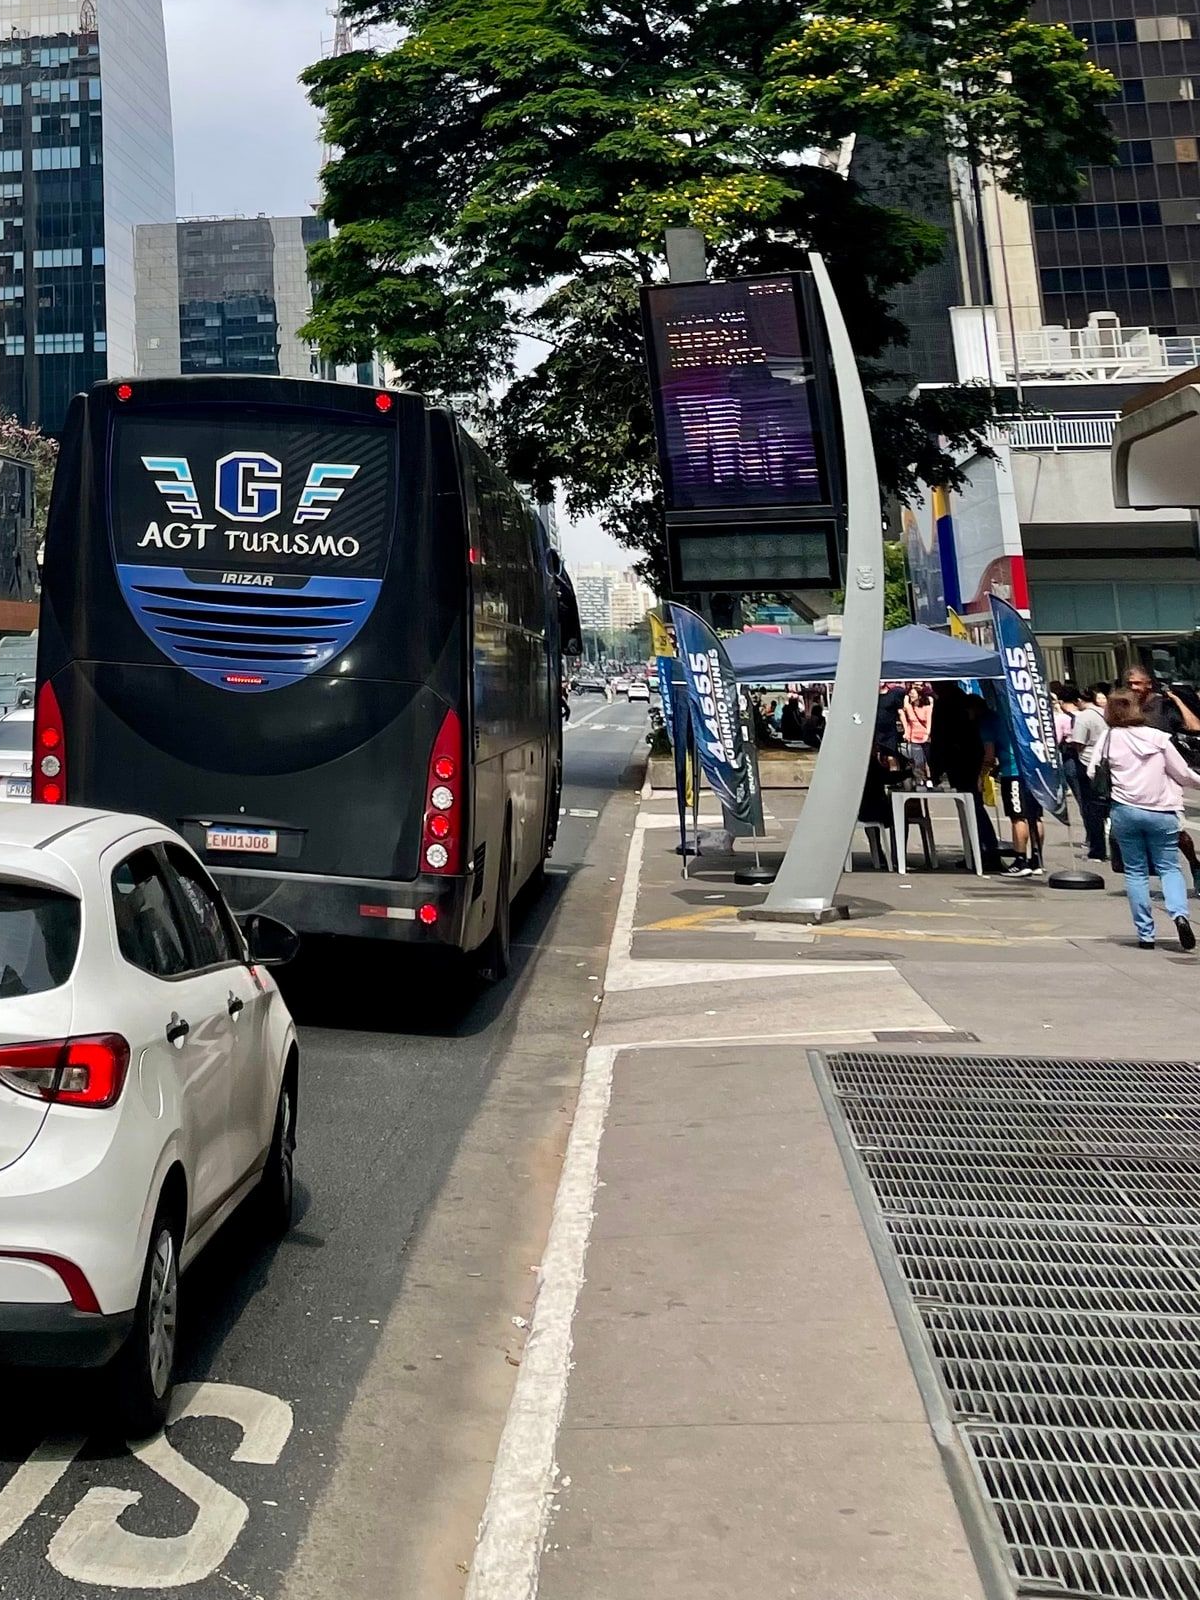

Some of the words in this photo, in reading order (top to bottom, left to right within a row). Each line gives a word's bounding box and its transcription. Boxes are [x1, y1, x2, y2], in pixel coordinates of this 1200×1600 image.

[137, 521, 217, 551] AGT
[224, 530, 360, 558] TURISMO
[221, 572, 274, 587] IRIZAR
[708, 648, 724, 701] NUNES
[688, 652, 726, 763] 44555
[1005, 646, 1047, 763] 44555
